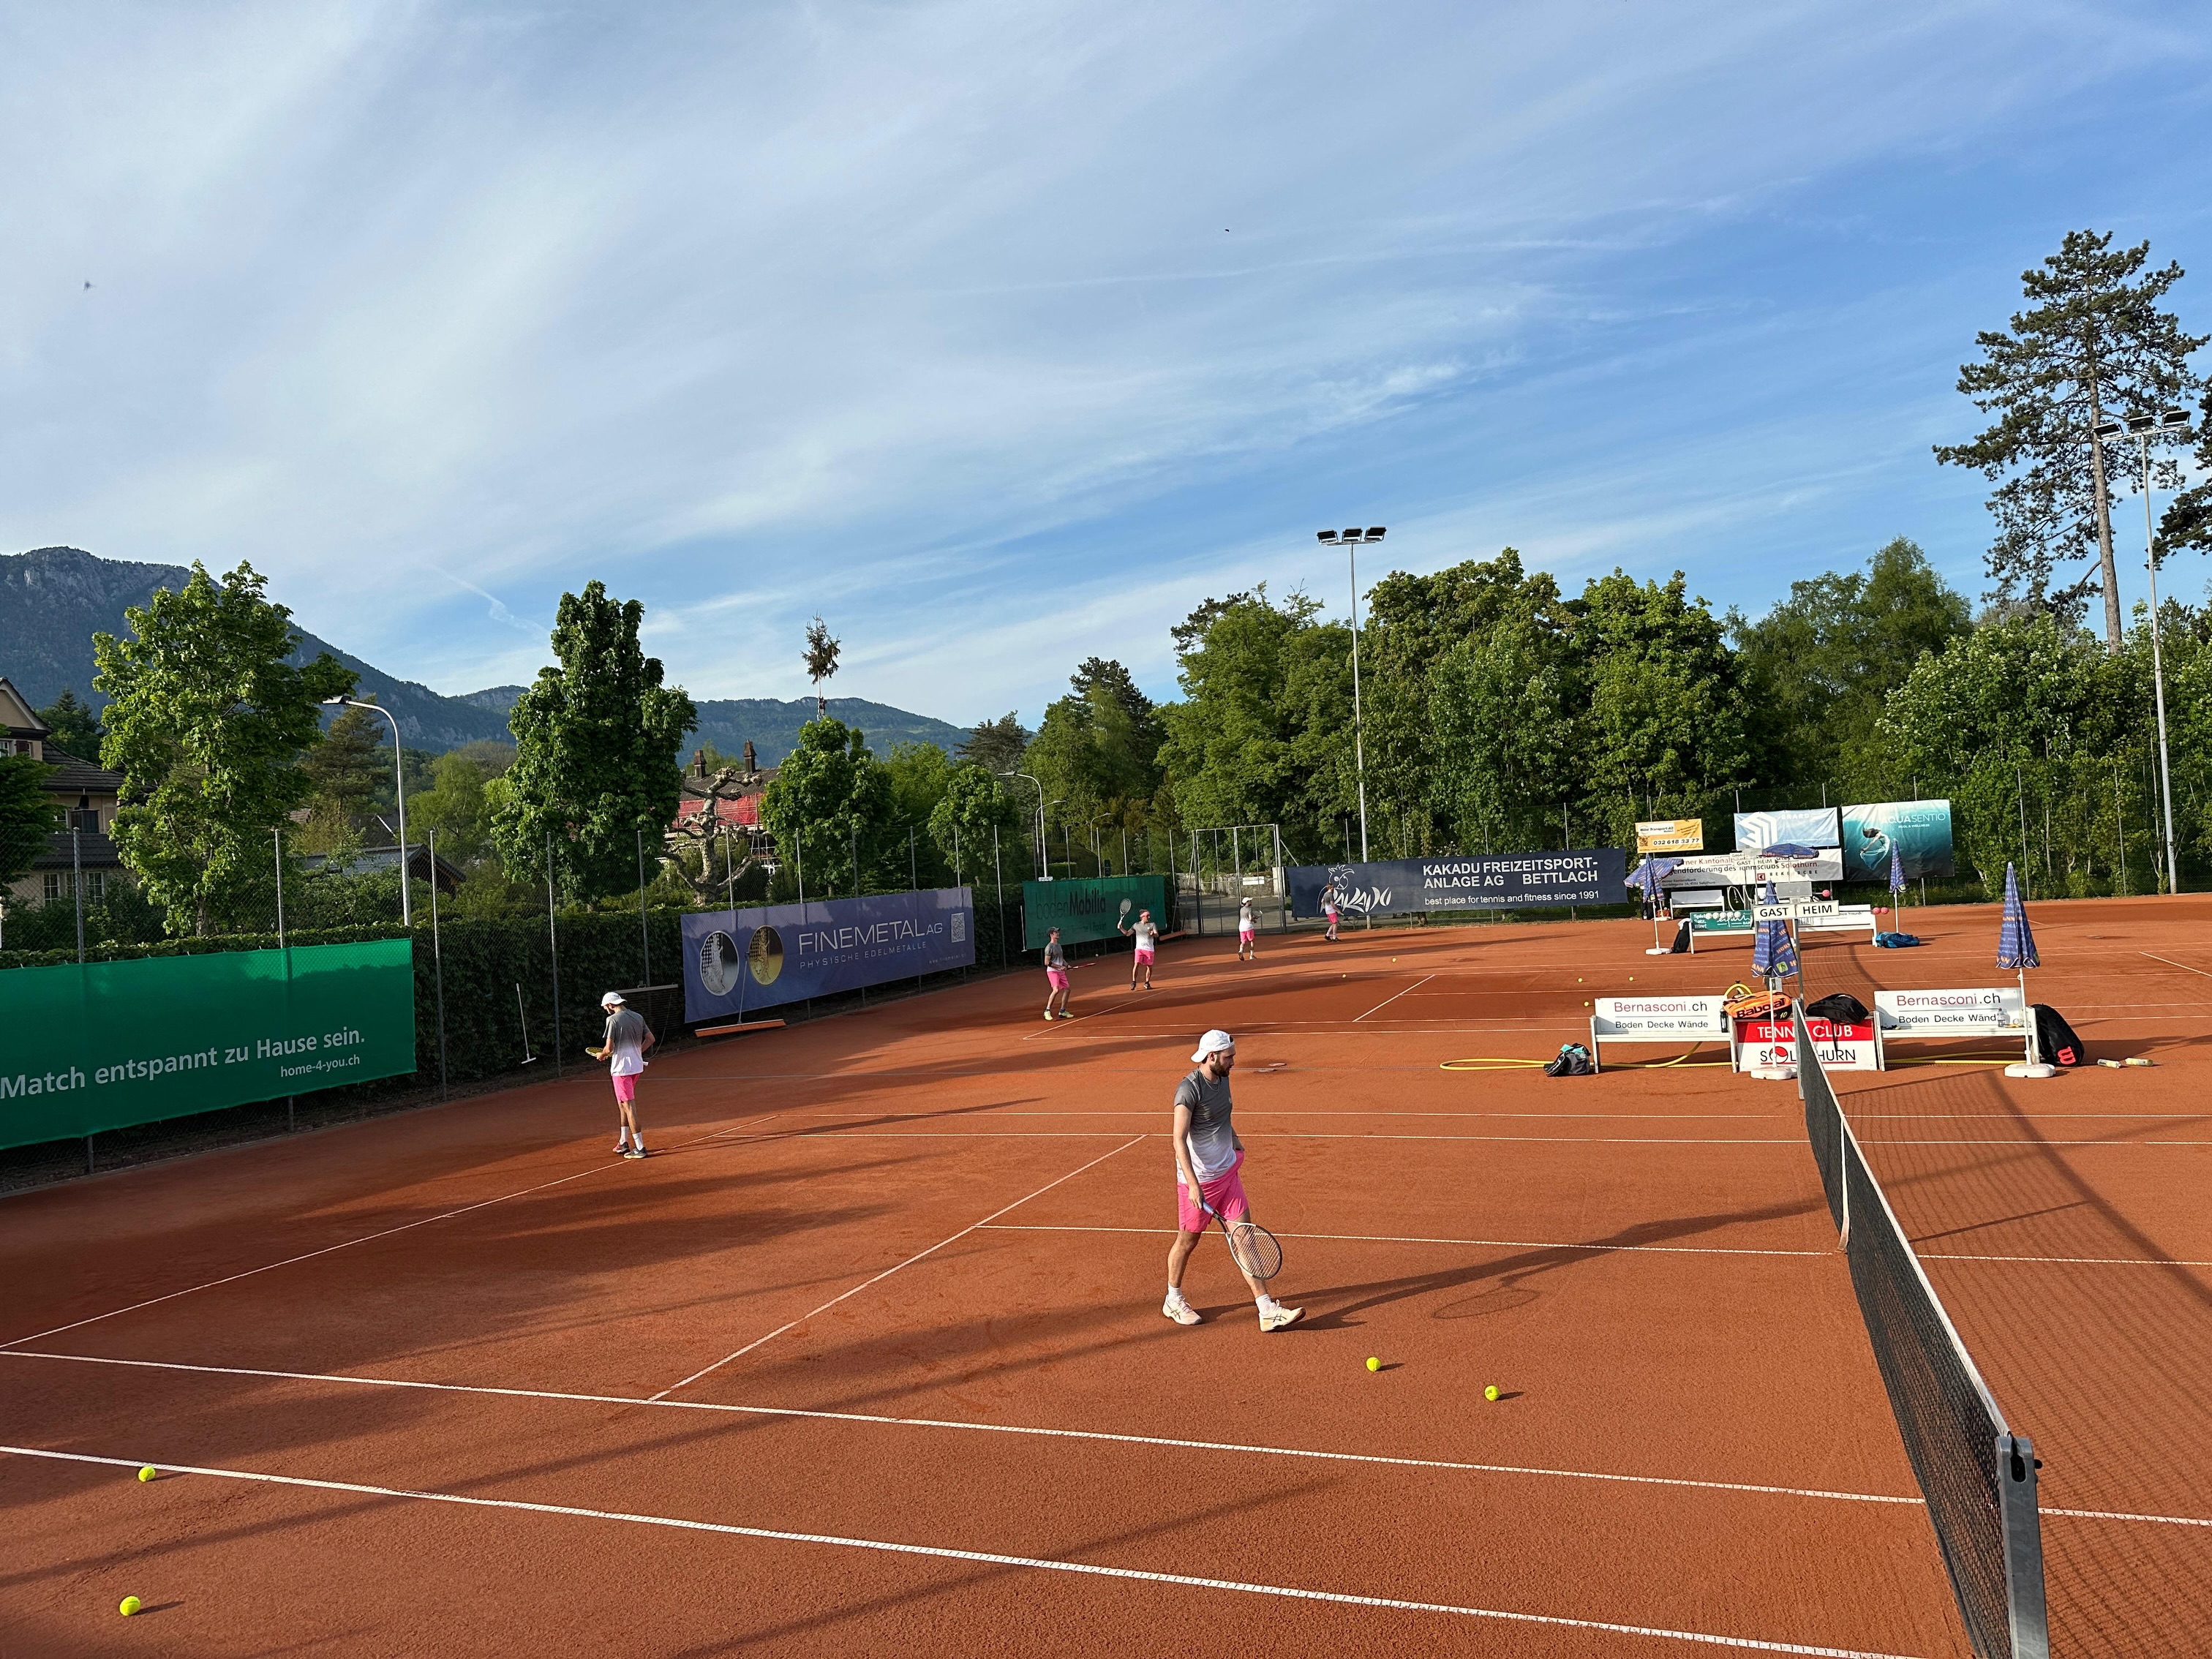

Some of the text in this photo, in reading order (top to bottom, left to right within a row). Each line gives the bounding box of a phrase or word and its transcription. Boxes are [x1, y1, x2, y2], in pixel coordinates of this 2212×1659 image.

[1423, 857, 1598, 876] KAKADU FREIZEITSPORT-
[1669, 865, 1722, 876] gendförderung
[1423, 870, 1598, 889] ANLAGE AG BETTLACH
[1444, 897, 1465, 906] place
[1467, 895, 1479, 903] for
[1480, 895, 1505, 903] tennis
[1507, 894, 1523, 903] and
[1524, 893, 1552, 902] fitness
[1554, 892, 1577, 900] since
[1579, 890, 1599, 899] 1991
[1760, 907, 1788, 917] GAST
[1803, 905, 1832, 914] HEIM
[799, 919, 943, 955] FINEMETAL AG
[800, 941, 927, 969] PHYSISCHE EDELMETALLE
[1614, 1001, 1707, 1012] Bernasconi.ch
[1897, 993, 2001, 1006] Bernasconi.ch
[1736, 998, 1786, 1018] Baboat
[1678, 1020, 1708, 1028] Wände
[1934, 1015, 1964, 1023] Decke
[1968, 1014, 1996, 1022] Wänd
[1757, 1025, 1853, 1039] TENN CLUB
[1, 1026, 365, 1098] Match entspannt zu Hause sein.
[280, 1054, 360, 1077] home-4-you.ch
